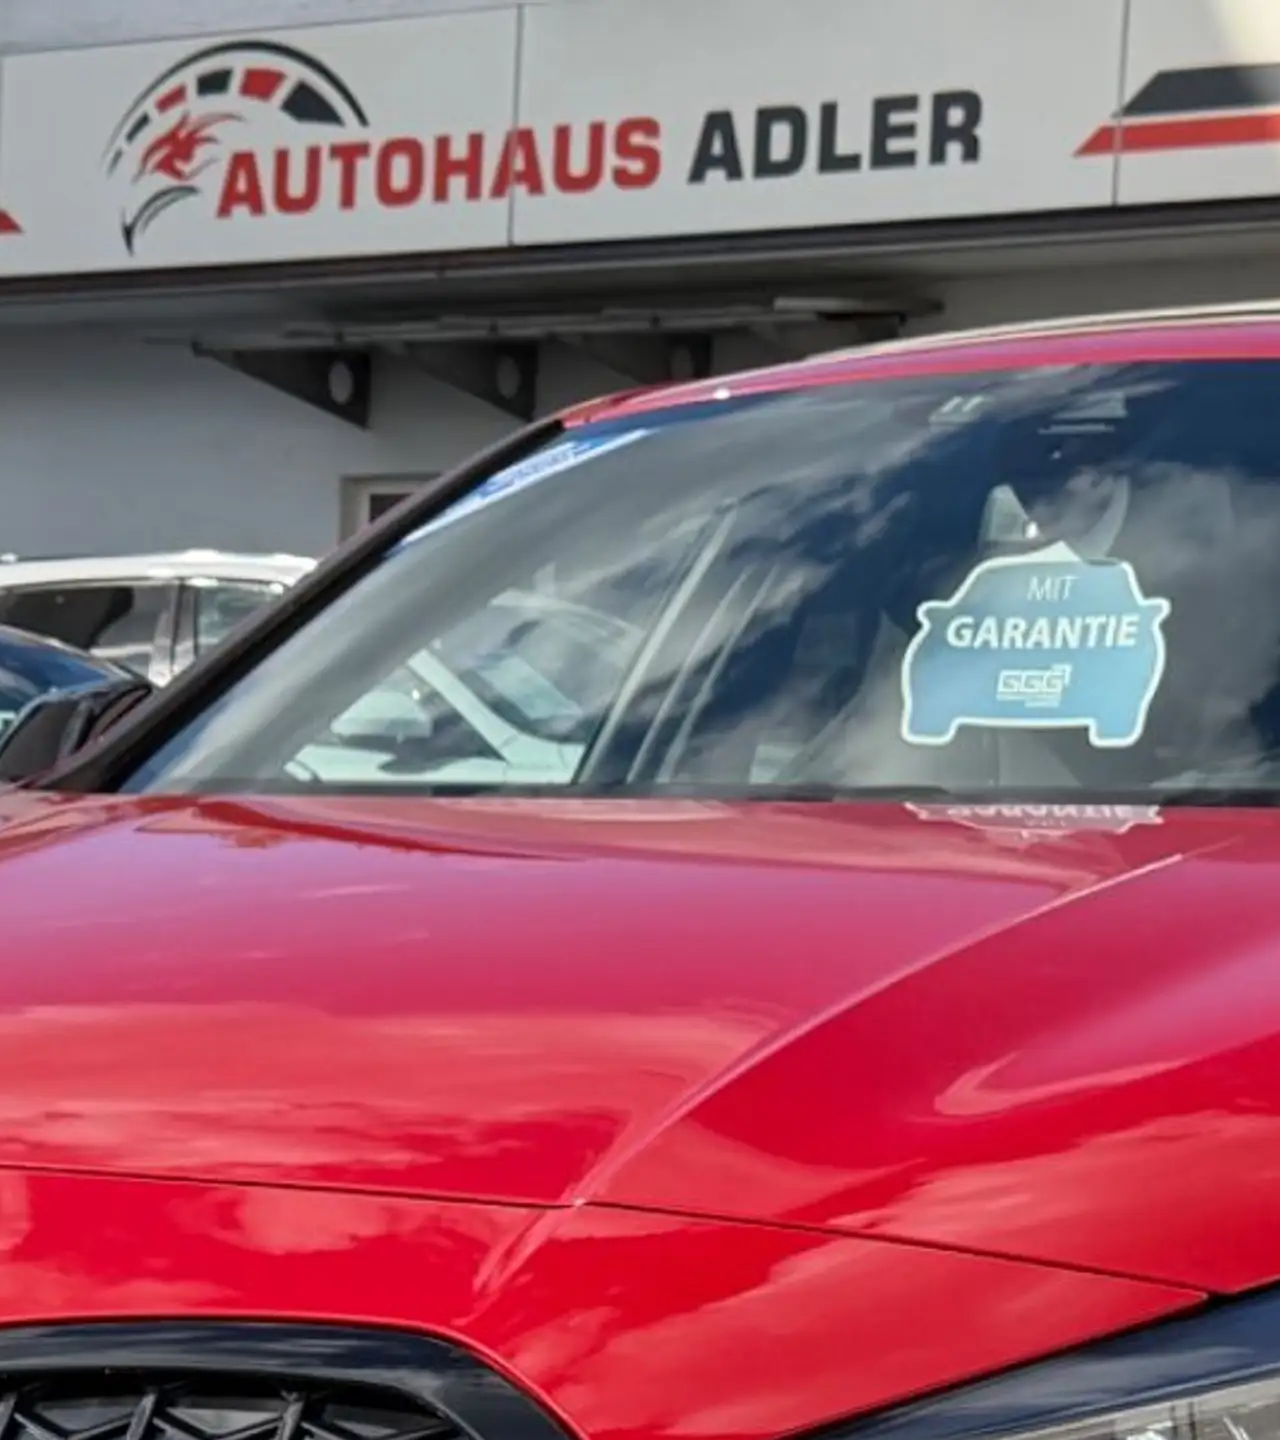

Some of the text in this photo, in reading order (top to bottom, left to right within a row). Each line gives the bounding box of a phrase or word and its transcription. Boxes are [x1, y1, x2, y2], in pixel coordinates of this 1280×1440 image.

[216, 89, 983, 218] AUTOHAUS ADLER
[1026, 575, 1079, 601] MIT
[946, 613, 1141, 650] GARANTIE
